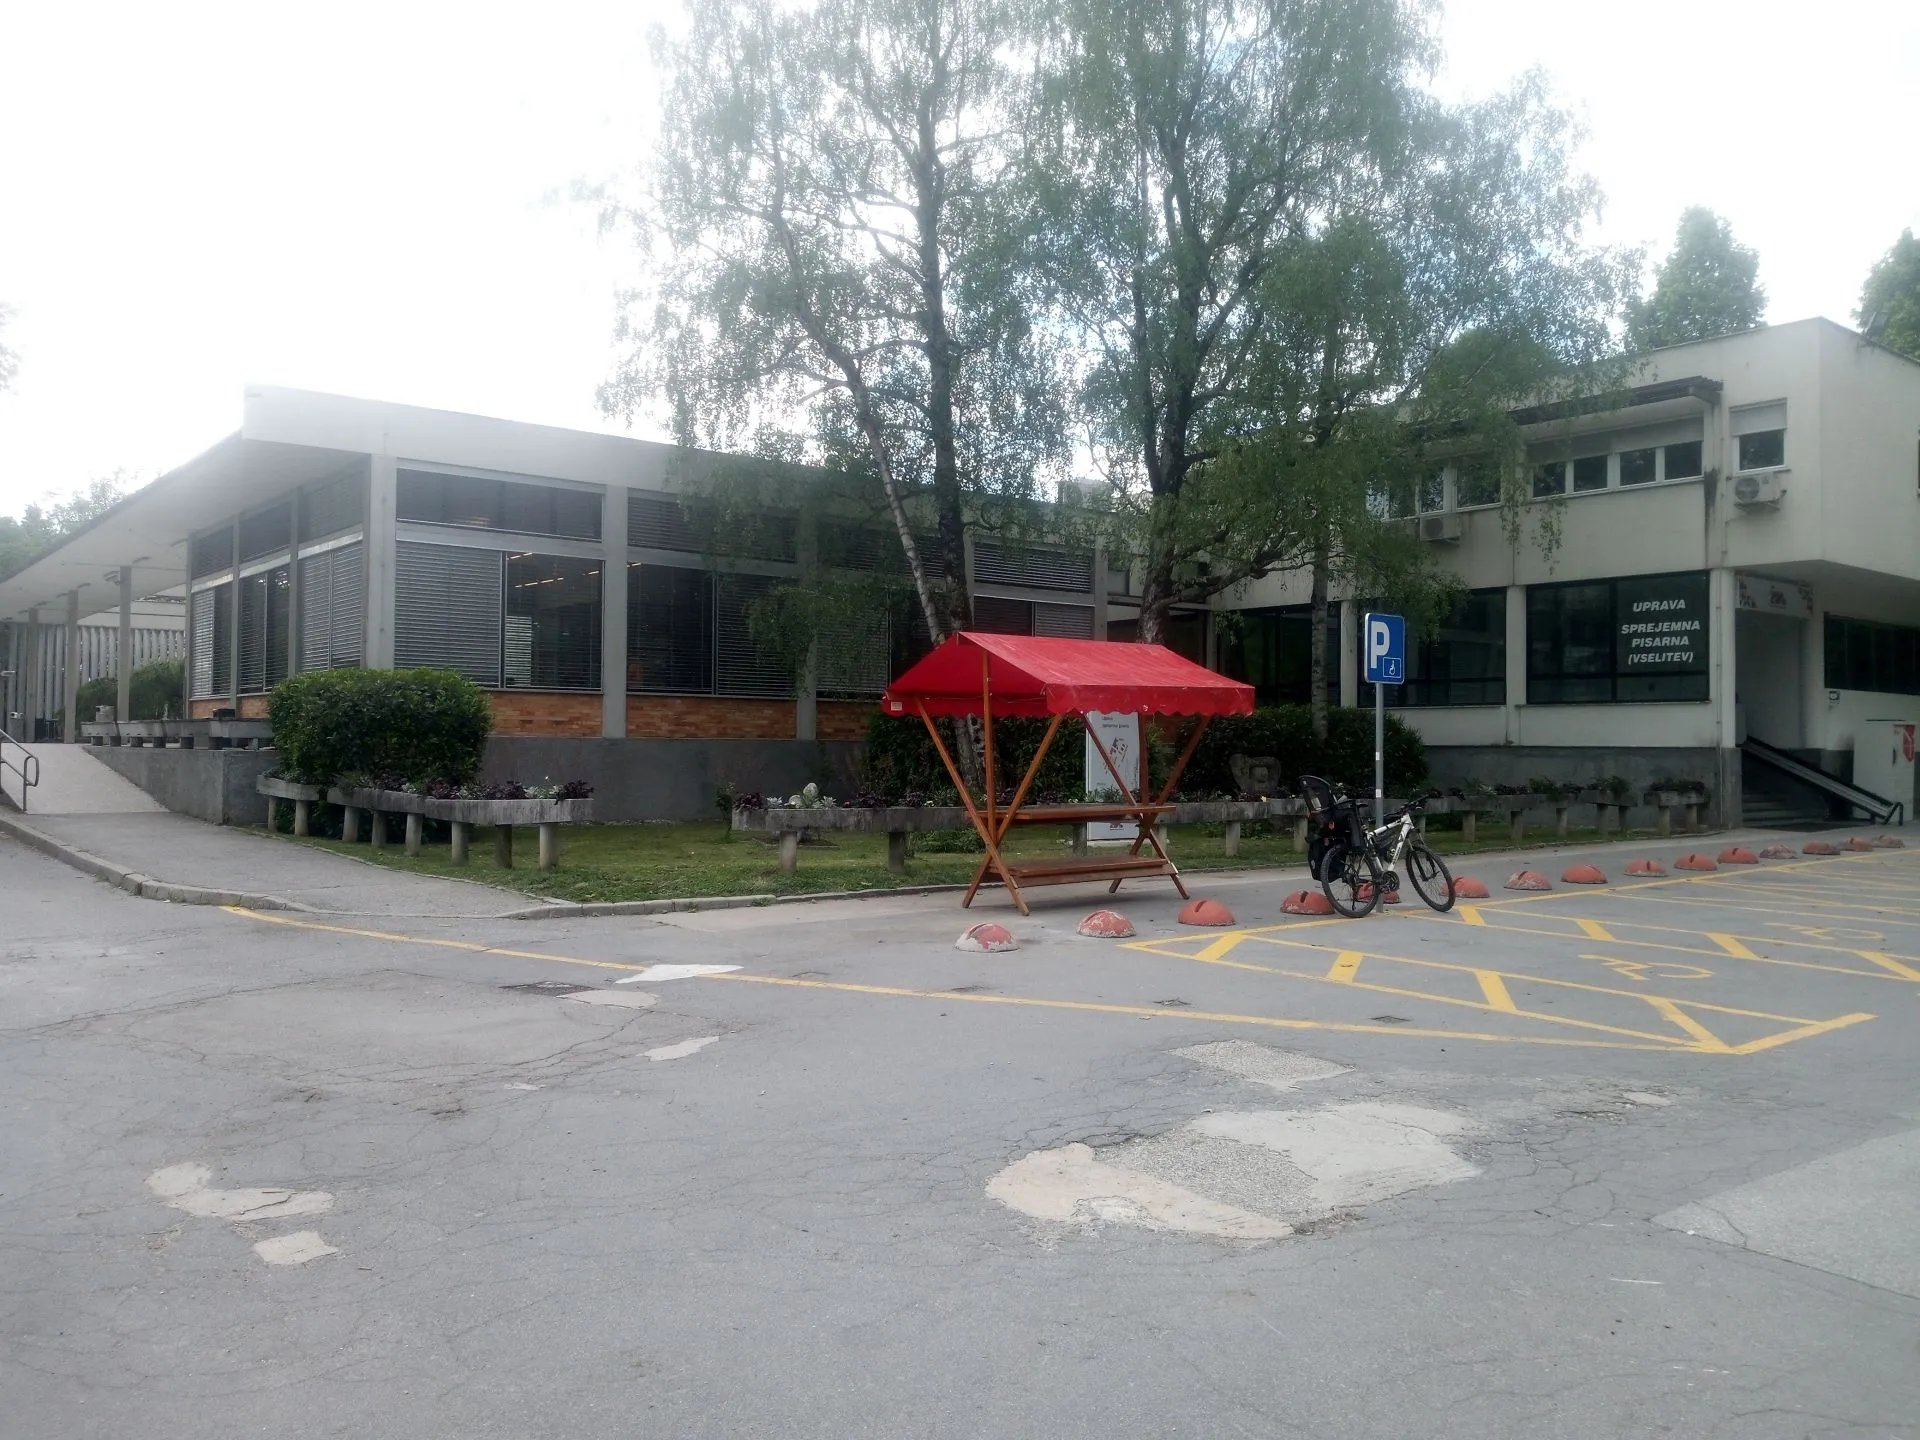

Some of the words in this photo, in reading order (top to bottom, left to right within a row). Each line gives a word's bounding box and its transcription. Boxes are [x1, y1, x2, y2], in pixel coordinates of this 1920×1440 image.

[1632, 599, 1686, 612] UPRAVA
[1621, 620, 1700, 634] SPREJEMNA
[1370, 621, 1390, 669] P
[1631, 636, 1689, 648] PISARNA
[1628, 652, 1694, 665] (VSELITEV)
